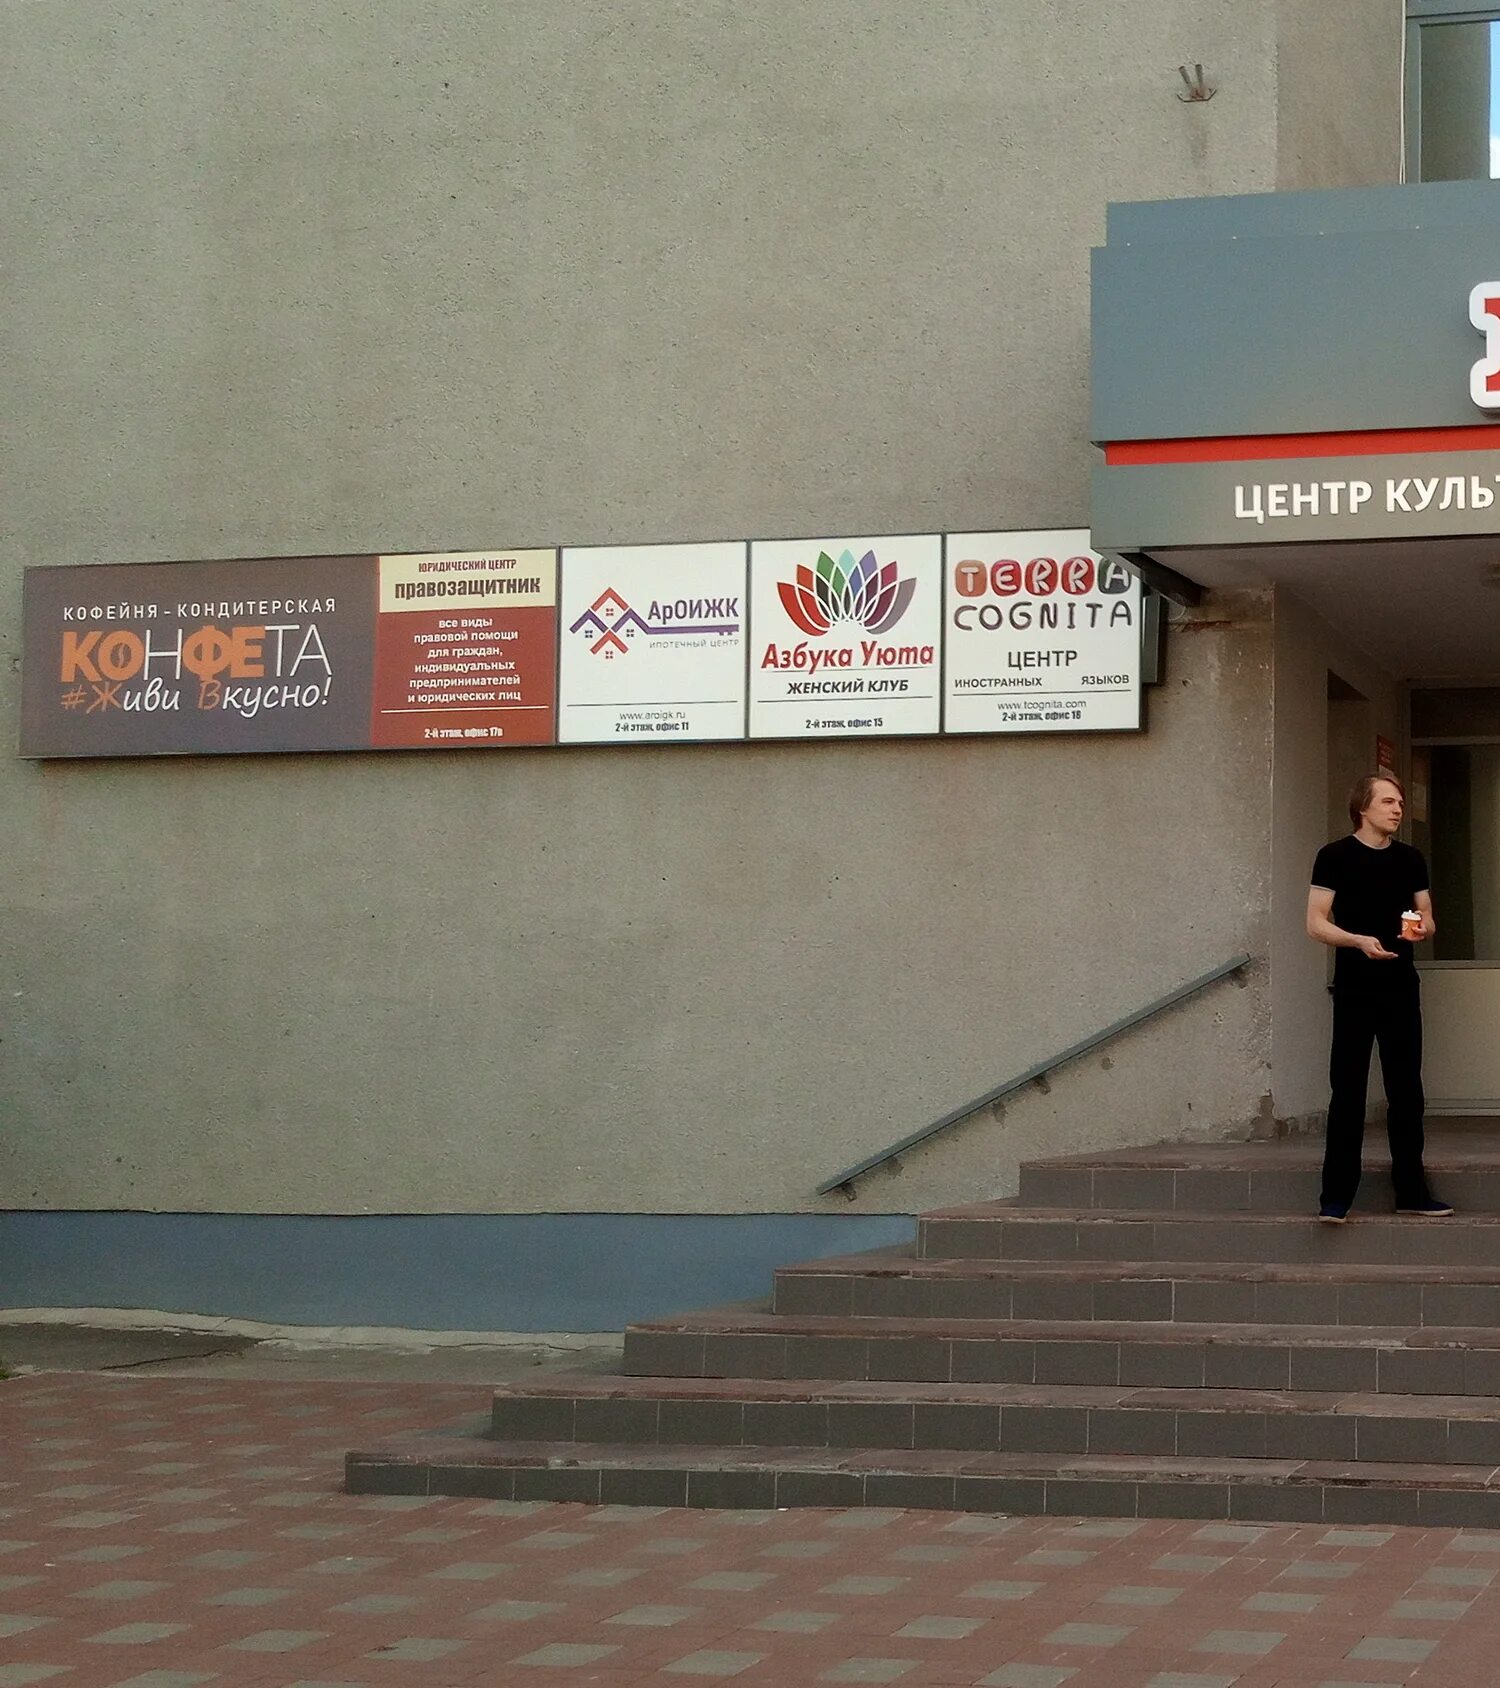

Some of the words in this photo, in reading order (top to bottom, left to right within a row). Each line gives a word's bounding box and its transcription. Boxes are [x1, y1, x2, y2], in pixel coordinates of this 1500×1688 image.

[1234, 482, 1372, 523] ЦЕНТР
[419, 558, 486, 572] ЮРИДИЧЕСКИЙ
[488, 558, 517, 572] ЦЕНТР
[958, 558, 1131, 595] TERRA
[395, 578, 540, 600] правозащитник
[63, 602, 158, 621] КОФЕЙНЯ
[178, 599, 336, 618] КОНДИТЕРСКАЯ
[648, 598, 739, 625] АрОИЖК
[953, 600, 1132, 631] COGNITA
[439, 619, 457, 628] все
[461, 618, 492, 629] виды
[414, 630, 468, 645] правовой
[471, 630, 518, 642] помощи
[710, 638, 739, 648] ЦЕНТР
[60, 624, 332, 682] КОНФЕТА
[428, 648, 449, 659] для
[452, 647, 503, 659] граждан,
[761, 641, 853, 674] Азбука
[860, 640, 934, 666] Уюта
[1007, 650, 1077, 670] ЦЕНТР
[415, 661, 515, 674] индивидуальных
[410, 674, 521, 689] предпринимателей
[786, 678, 864, 694] ЖЕНСКИЙ
[867, 679, 909, 693] КЛУБ
[954, 677, 1042, 689] ИНОСТРАННЫХ
[1081, 674, 1130, 686] ЯЗЫКОВ
[61, 677, 180, 714] #Живи
[198, 677, 332, 718] Вкусно!
[408, 694, 415, 703] и
[418, 691, 495, 704] юридических
[498, 691, 521, 702] лиц
[681, 721, 689, 731] 11
[873, 717, 883, 727] 15
